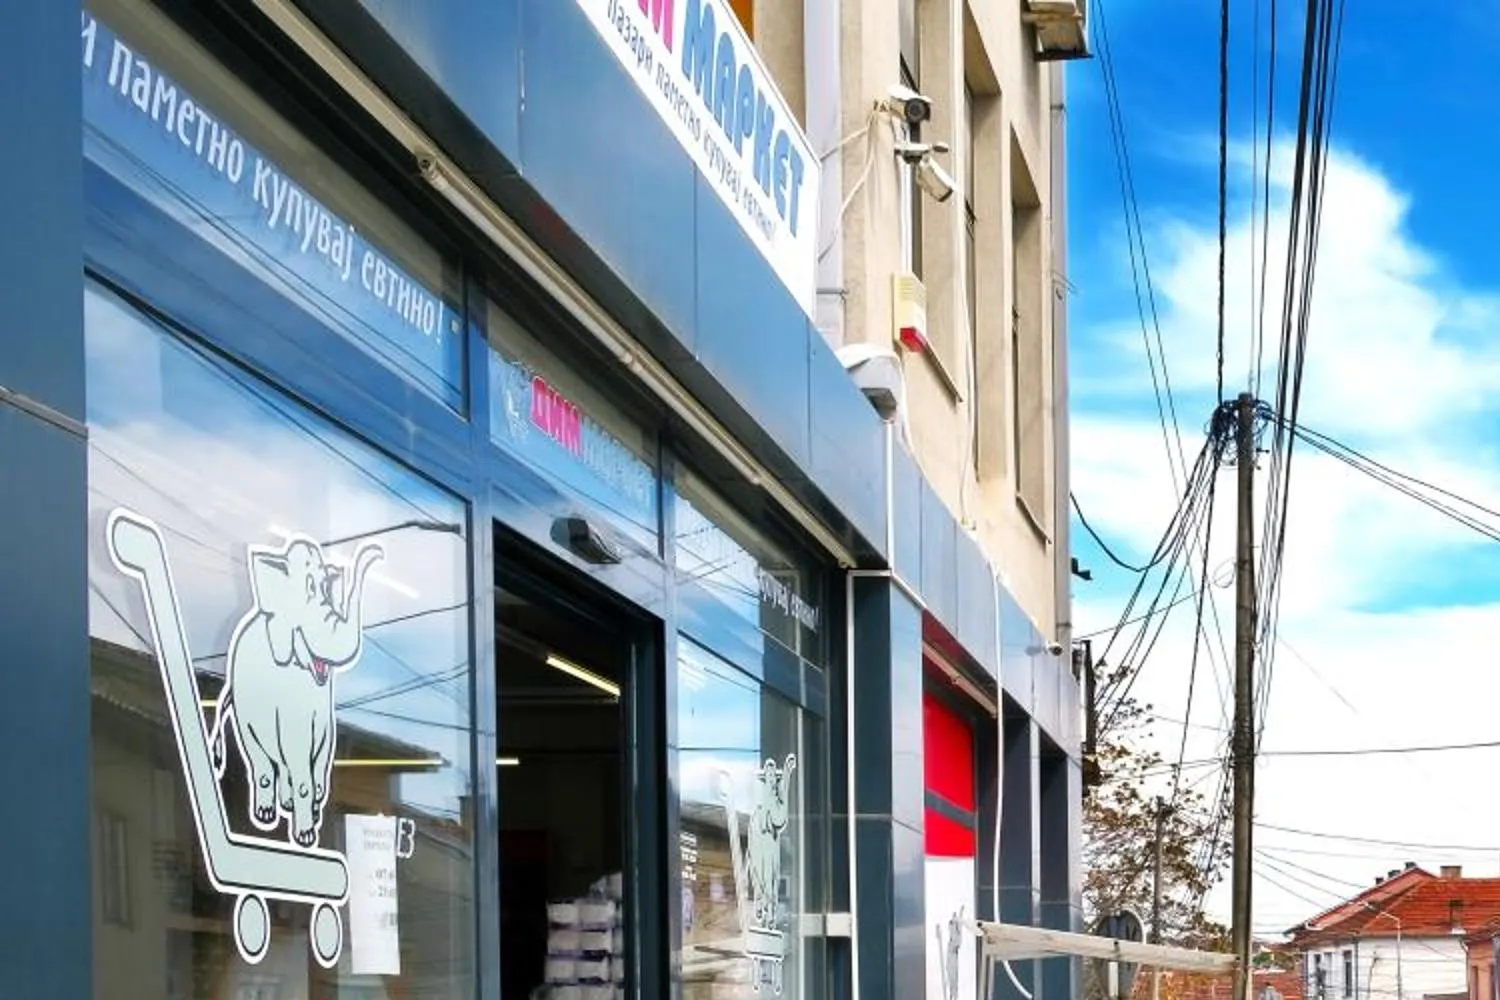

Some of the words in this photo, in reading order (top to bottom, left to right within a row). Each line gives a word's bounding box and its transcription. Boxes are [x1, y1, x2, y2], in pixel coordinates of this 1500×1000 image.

[108, 39, 243, 184] паметно
[252, 157, 357, 282] купувај
[361, 249, 446, 344] евтино!
[530, 376, 584, 457] ДИМ
